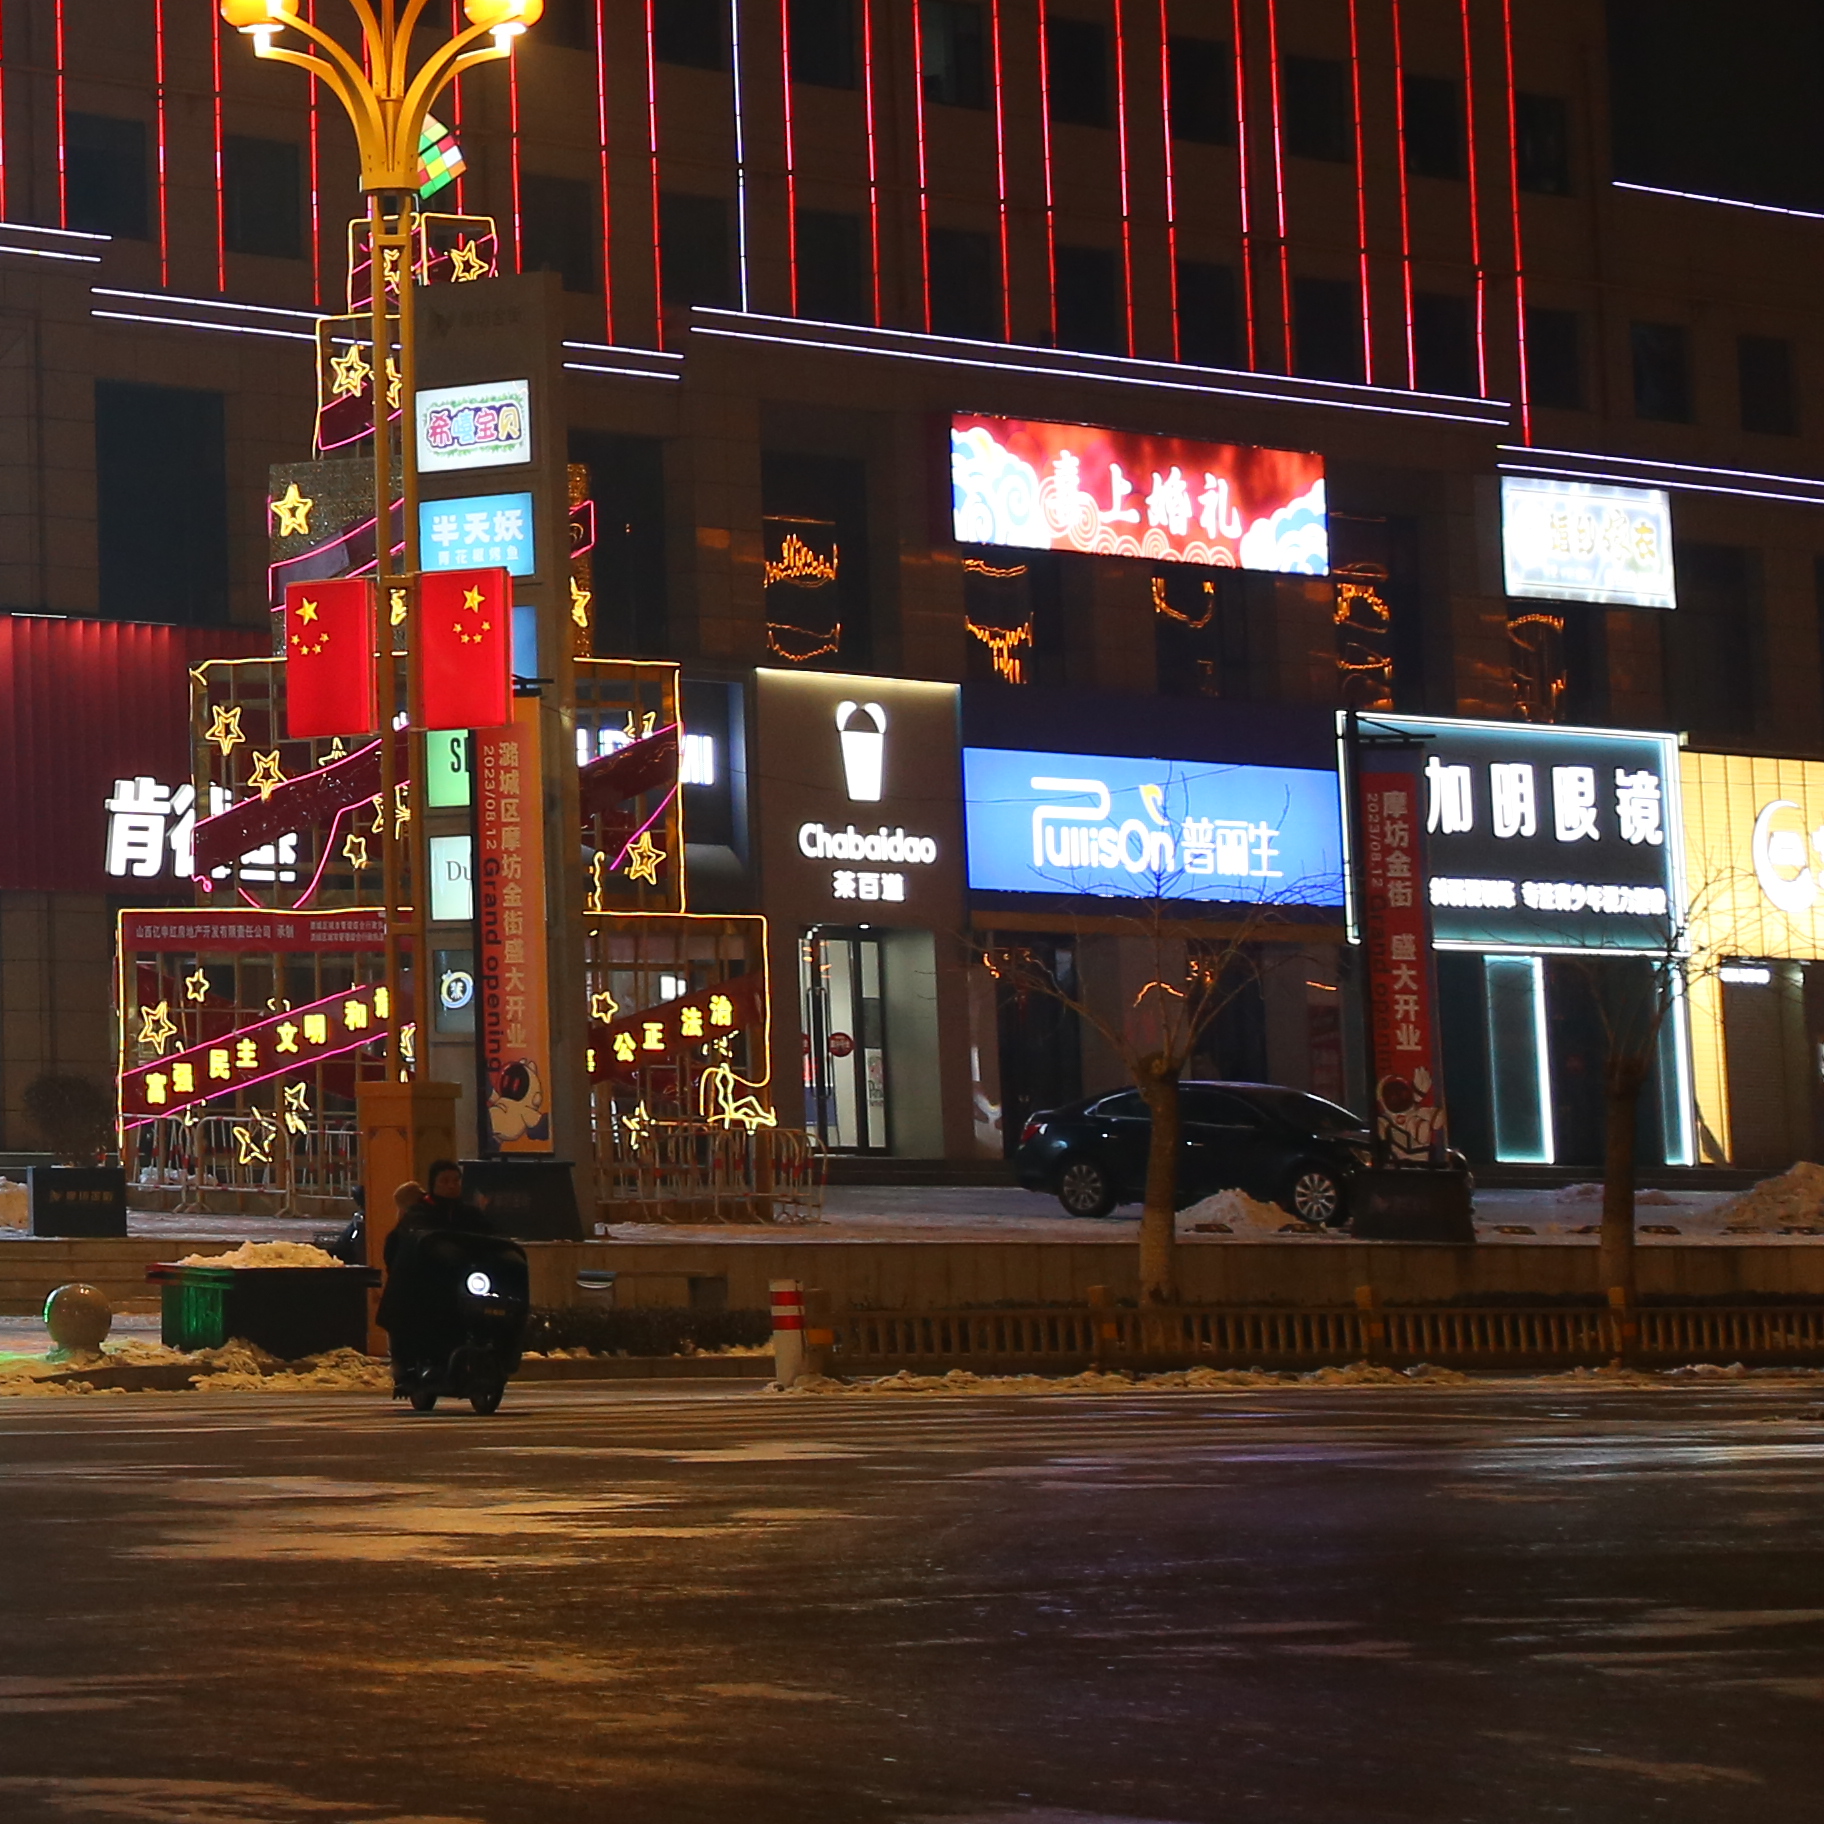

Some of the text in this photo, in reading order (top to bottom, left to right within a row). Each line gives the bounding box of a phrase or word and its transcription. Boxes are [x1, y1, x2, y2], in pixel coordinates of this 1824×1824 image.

[431, 509, 524, 547] 半天妖
[798, 822, 938, 865] Chabaidao
[1180, 816, 1284, 879] 普丽生
[484, 857, 502, 945] Grand
[832, 870, 906, 903] 茶百道
[1381, 789, 1423, 1052] 摩坊金街 盛大开业
[208, 1038, 259, 1080] 民主
[275, 1013, 328, 1053] 文明
[613, 1021, 666, 1064] 公正
[680, 993, 734, 1038] 法治
